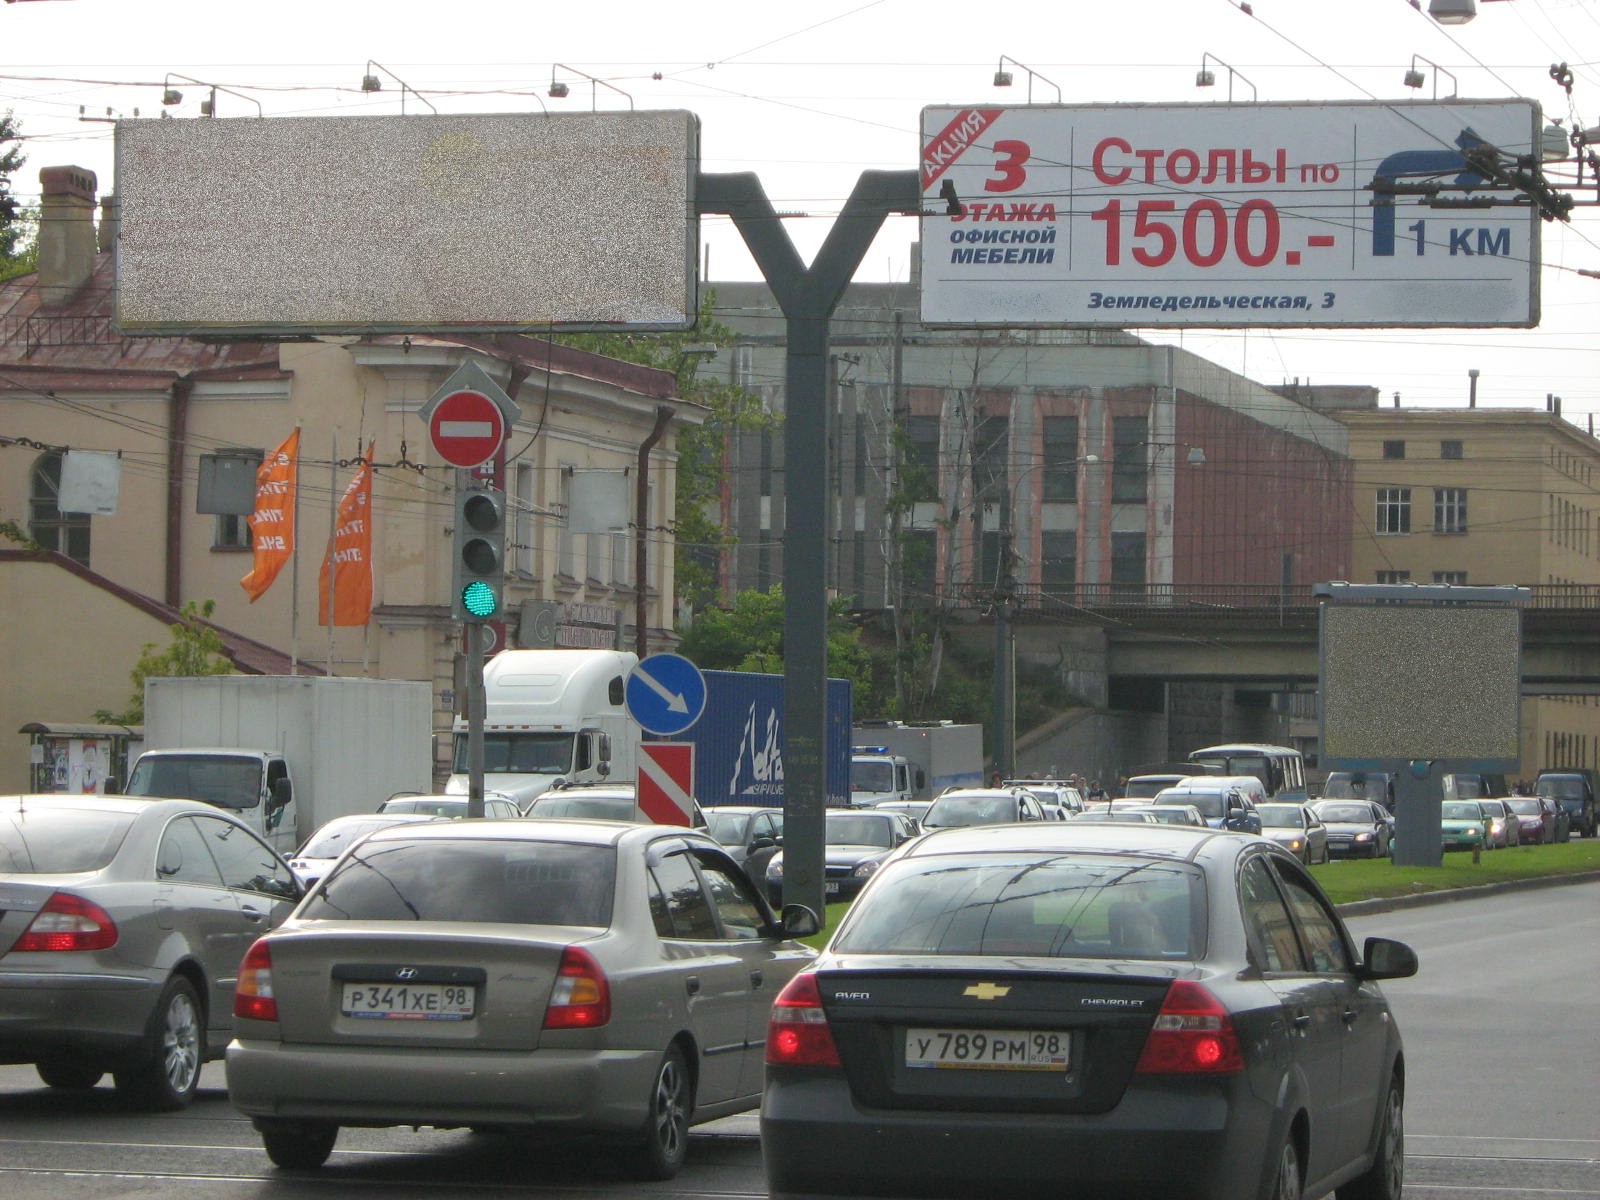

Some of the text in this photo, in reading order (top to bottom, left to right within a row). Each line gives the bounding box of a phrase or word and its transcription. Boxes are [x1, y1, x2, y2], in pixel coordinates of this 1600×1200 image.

[924, 110, 987, 178] АКЦИЯ
[984, 139, 1031, 193] 3
[1092, 137, 1340, 186] Столы по
[950, 203, 1057, 222] ЭТАЖА
[950, 225, 1057, 244] ОФИСНОЙ
[1408, 219, 1425, 257] 1
[950, 248, 1056, 264] МЕБЕЛИ
[1087, 291, 1336, 312] Земледельческая, 3
[444, 988, 467, 1006] 98
[835, 991, 870, 1000] AVEO
[1080, 998, 1145, 1007] CHEVROLET
[1033, 1033, 1060, 1054] 98
